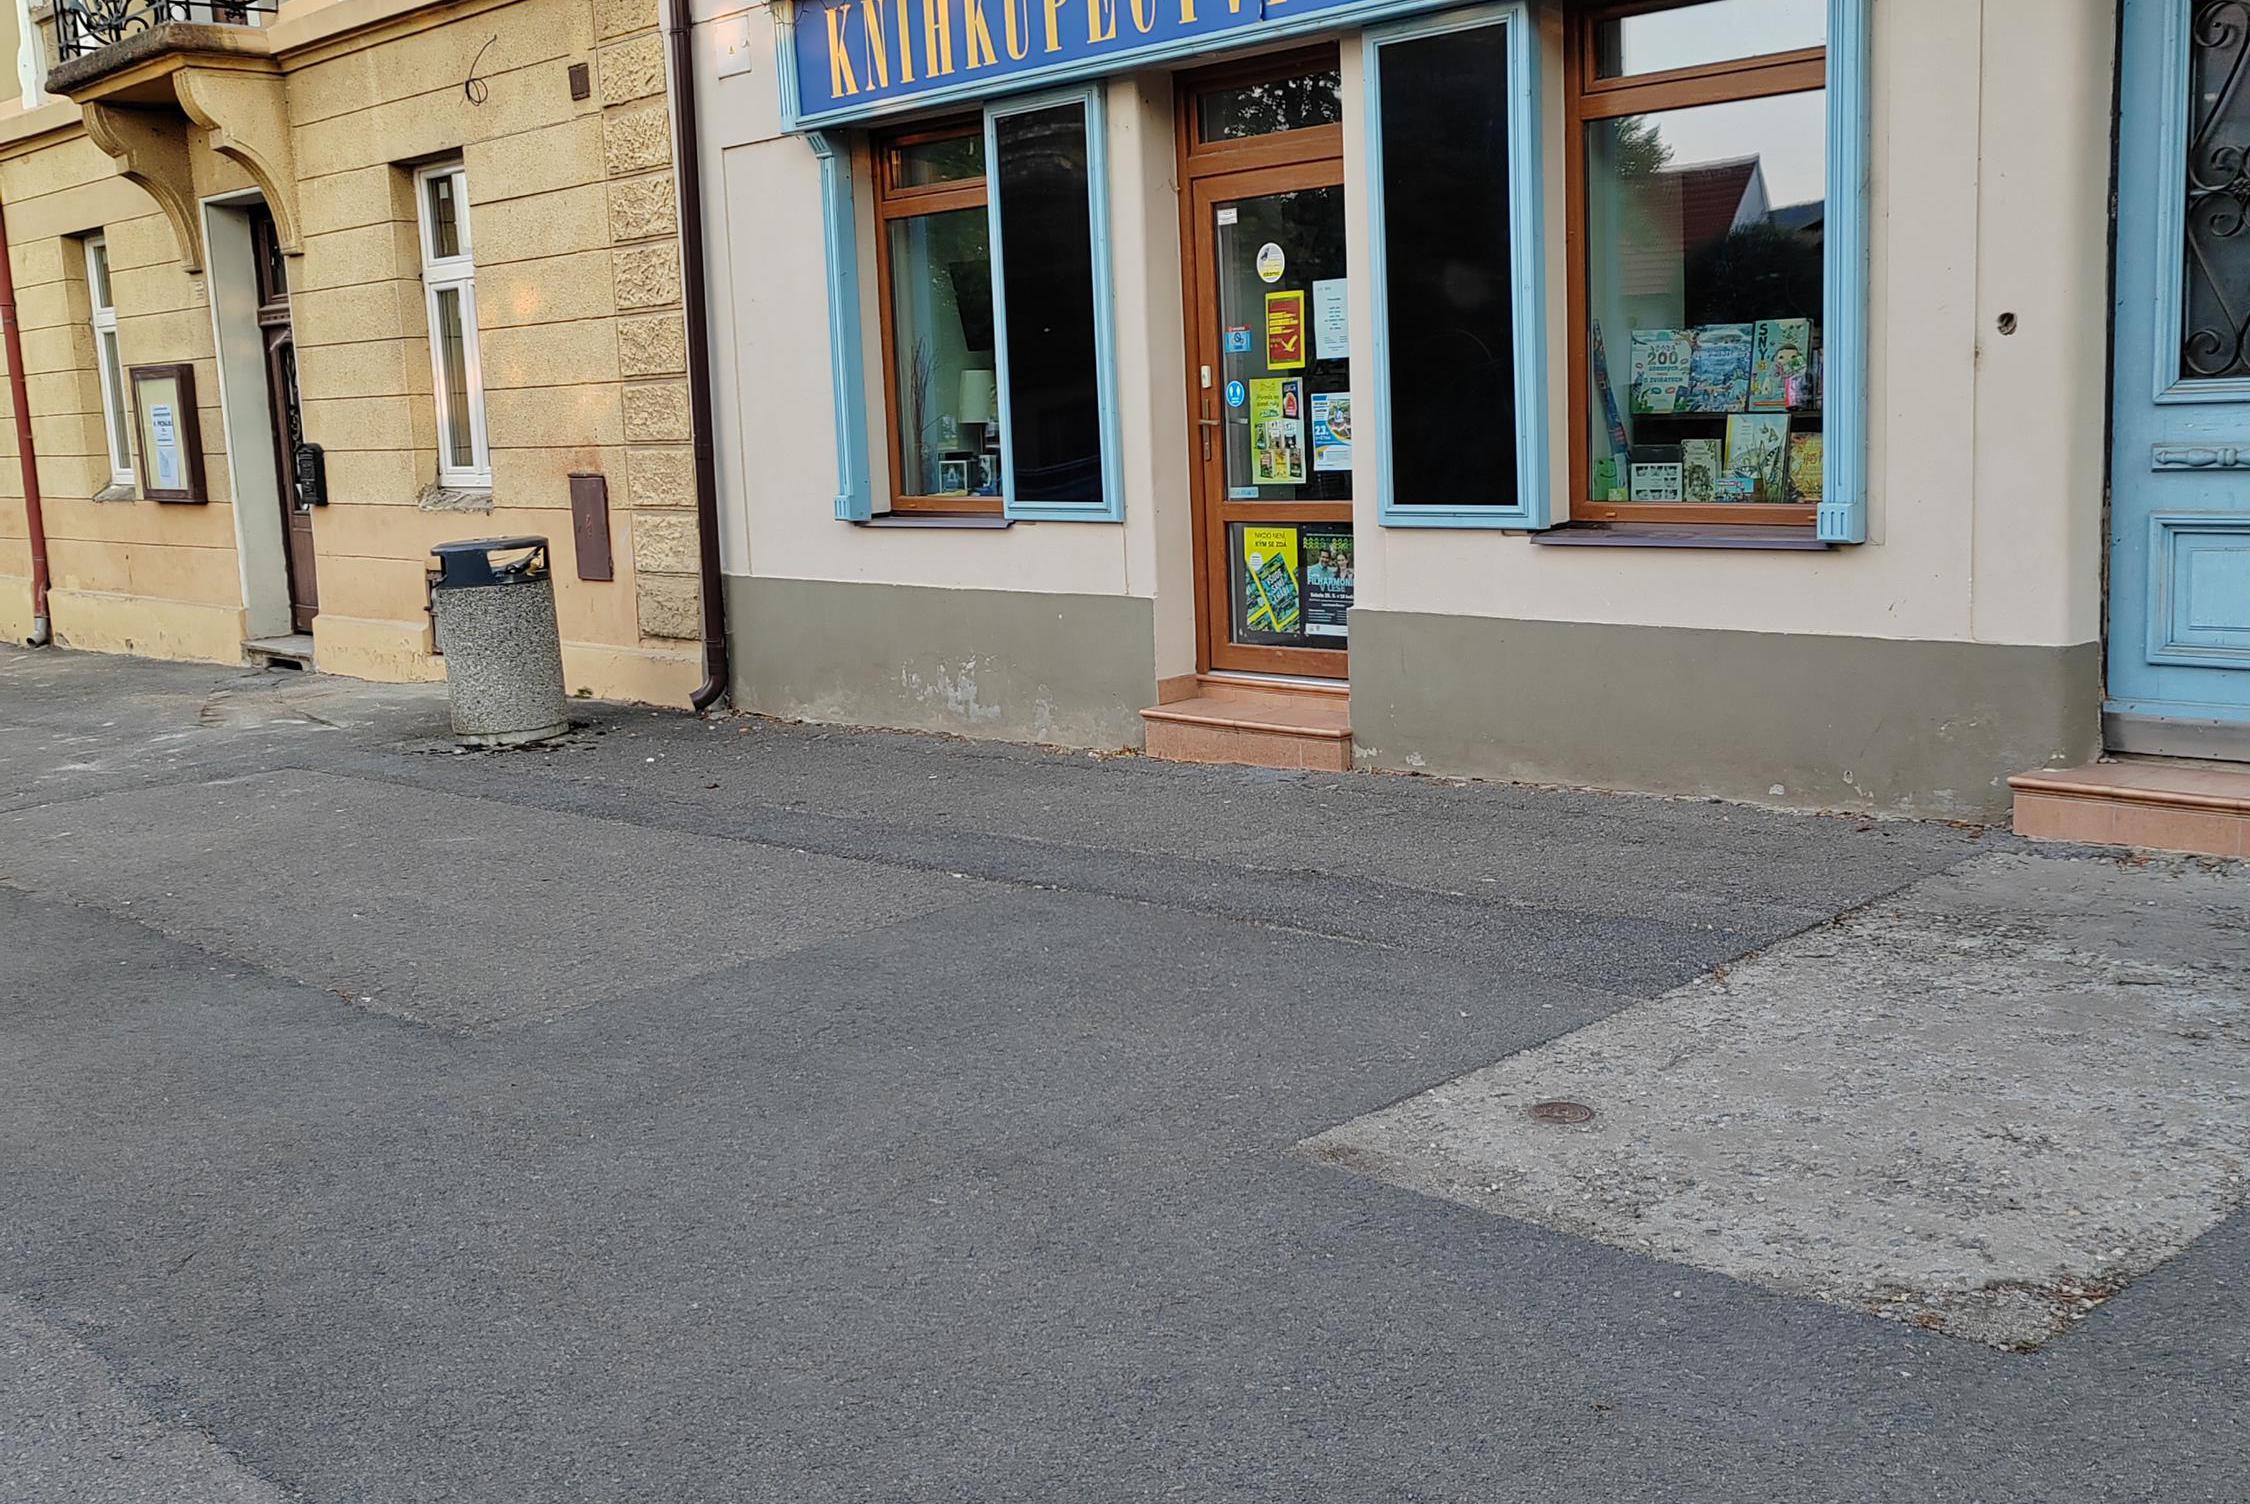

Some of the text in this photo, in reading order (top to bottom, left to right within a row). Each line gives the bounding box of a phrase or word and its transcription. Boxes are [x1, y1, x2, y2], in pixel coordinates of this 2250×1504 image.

[825, 0, 1288, 98] KNIHKUPE
[1758, 323, 1768, 361] SNY
[1648, 351, 1678, 366] 200
[1315, 425, 1328, 436] 23.
[1307, 575, 1354, 586] FILHARMONI
